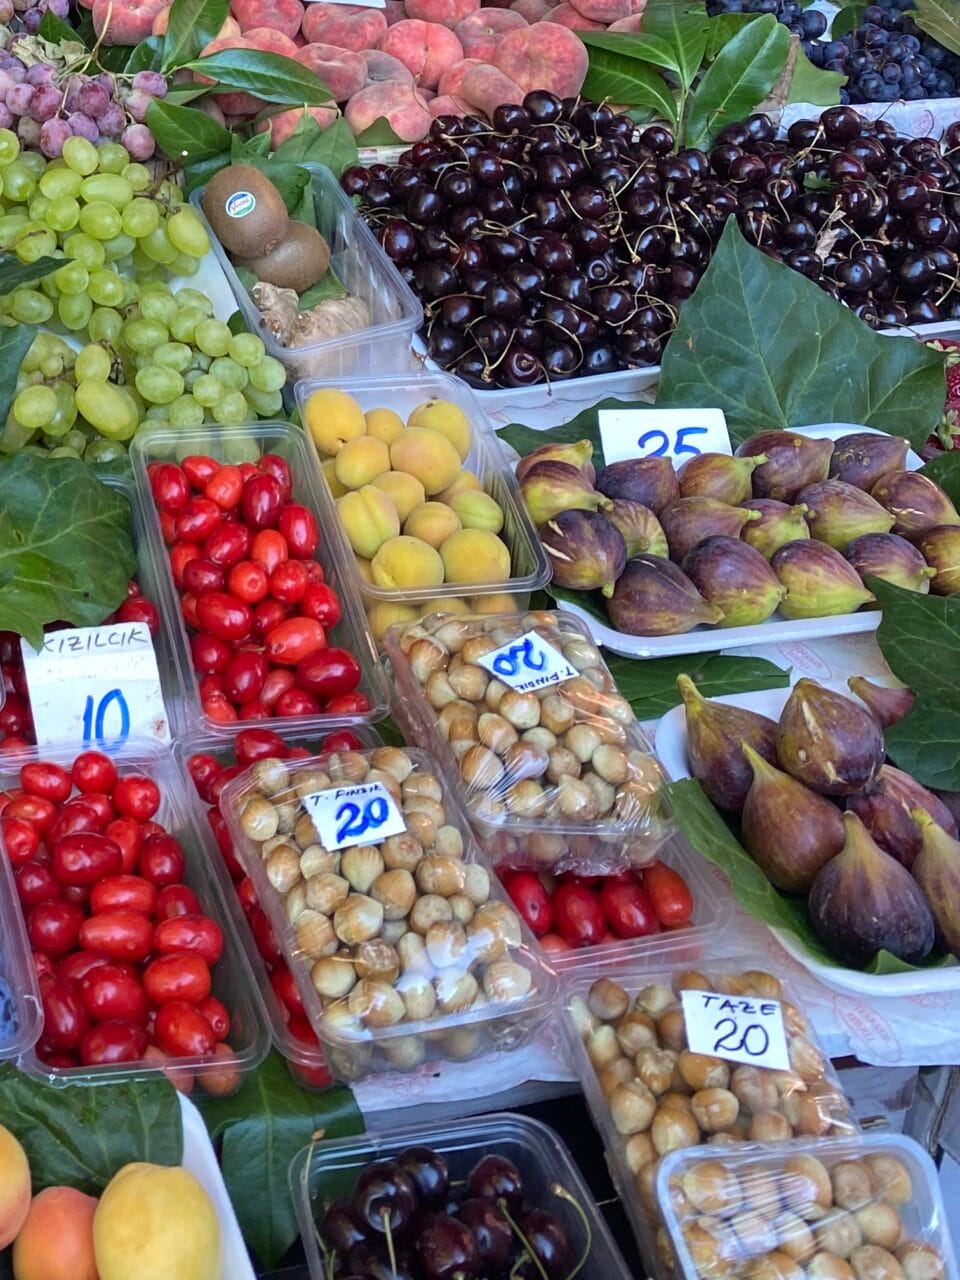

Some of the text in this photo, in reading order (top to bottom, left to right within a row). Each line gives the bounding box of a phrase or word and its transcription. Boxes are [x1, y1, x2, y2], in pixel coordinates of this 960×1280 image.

[638, 426, 708, 458] 25
[493, 637, 546, 676] 20
[82, 688, 131, 754] 10
[335, 797, 389, 844] 20
[701, 994, 778, 1016] TAZE
[713, 1017, 770, 1056] 20
